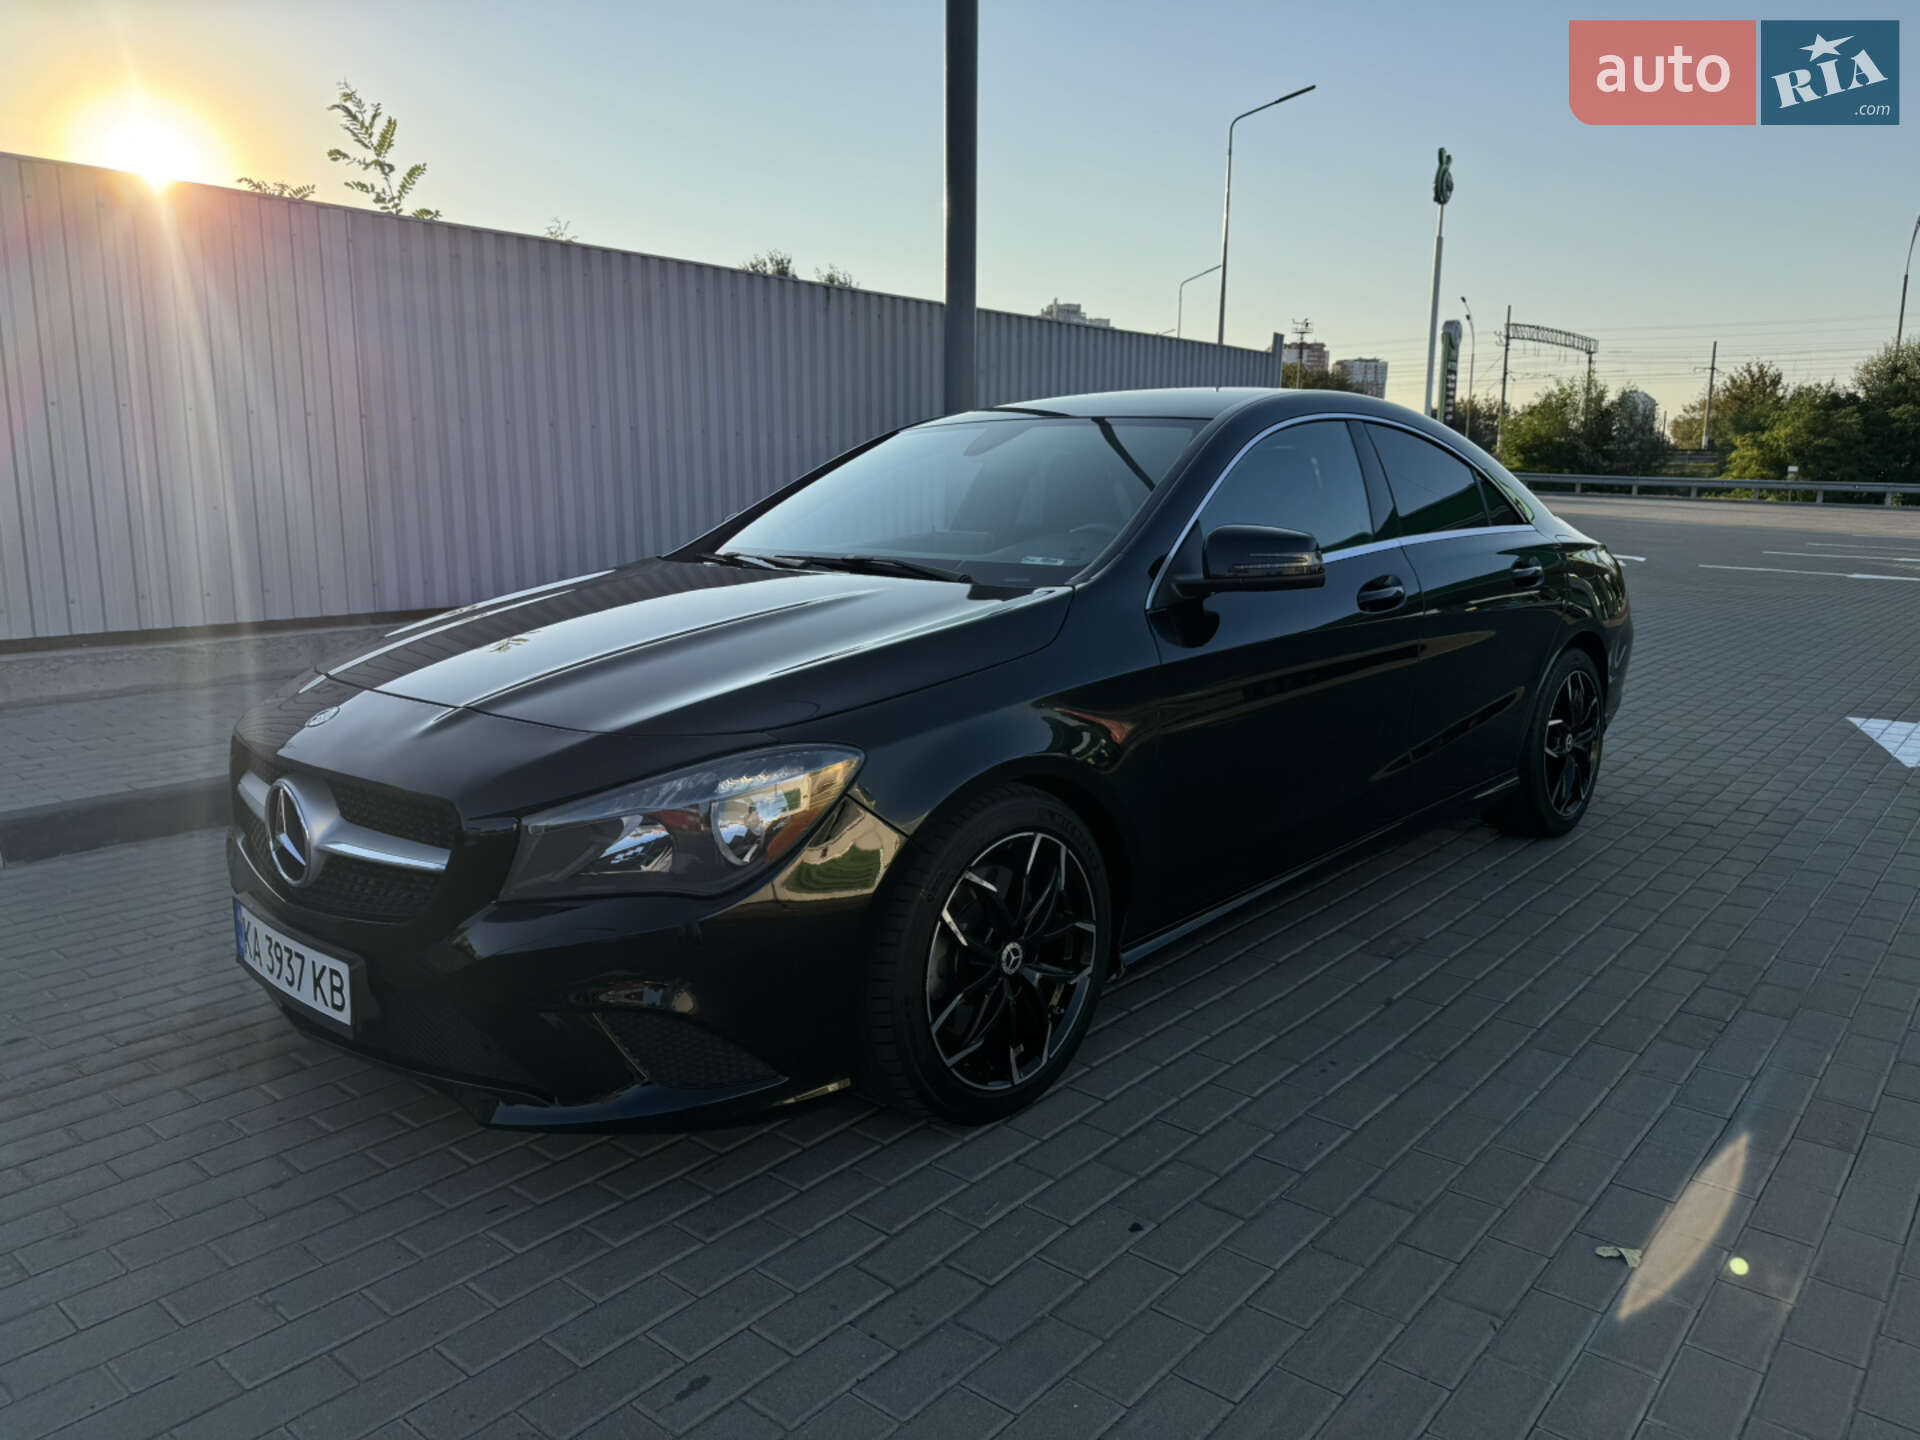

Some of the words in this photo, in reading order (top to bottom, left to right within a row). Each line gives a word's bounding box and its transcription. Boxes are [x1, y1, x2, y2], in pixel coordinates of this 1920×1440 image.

[241, 917, 263, 967] KA
[265, 934, 305, 992] 3937
[312, 960, 345, 1012] KB
